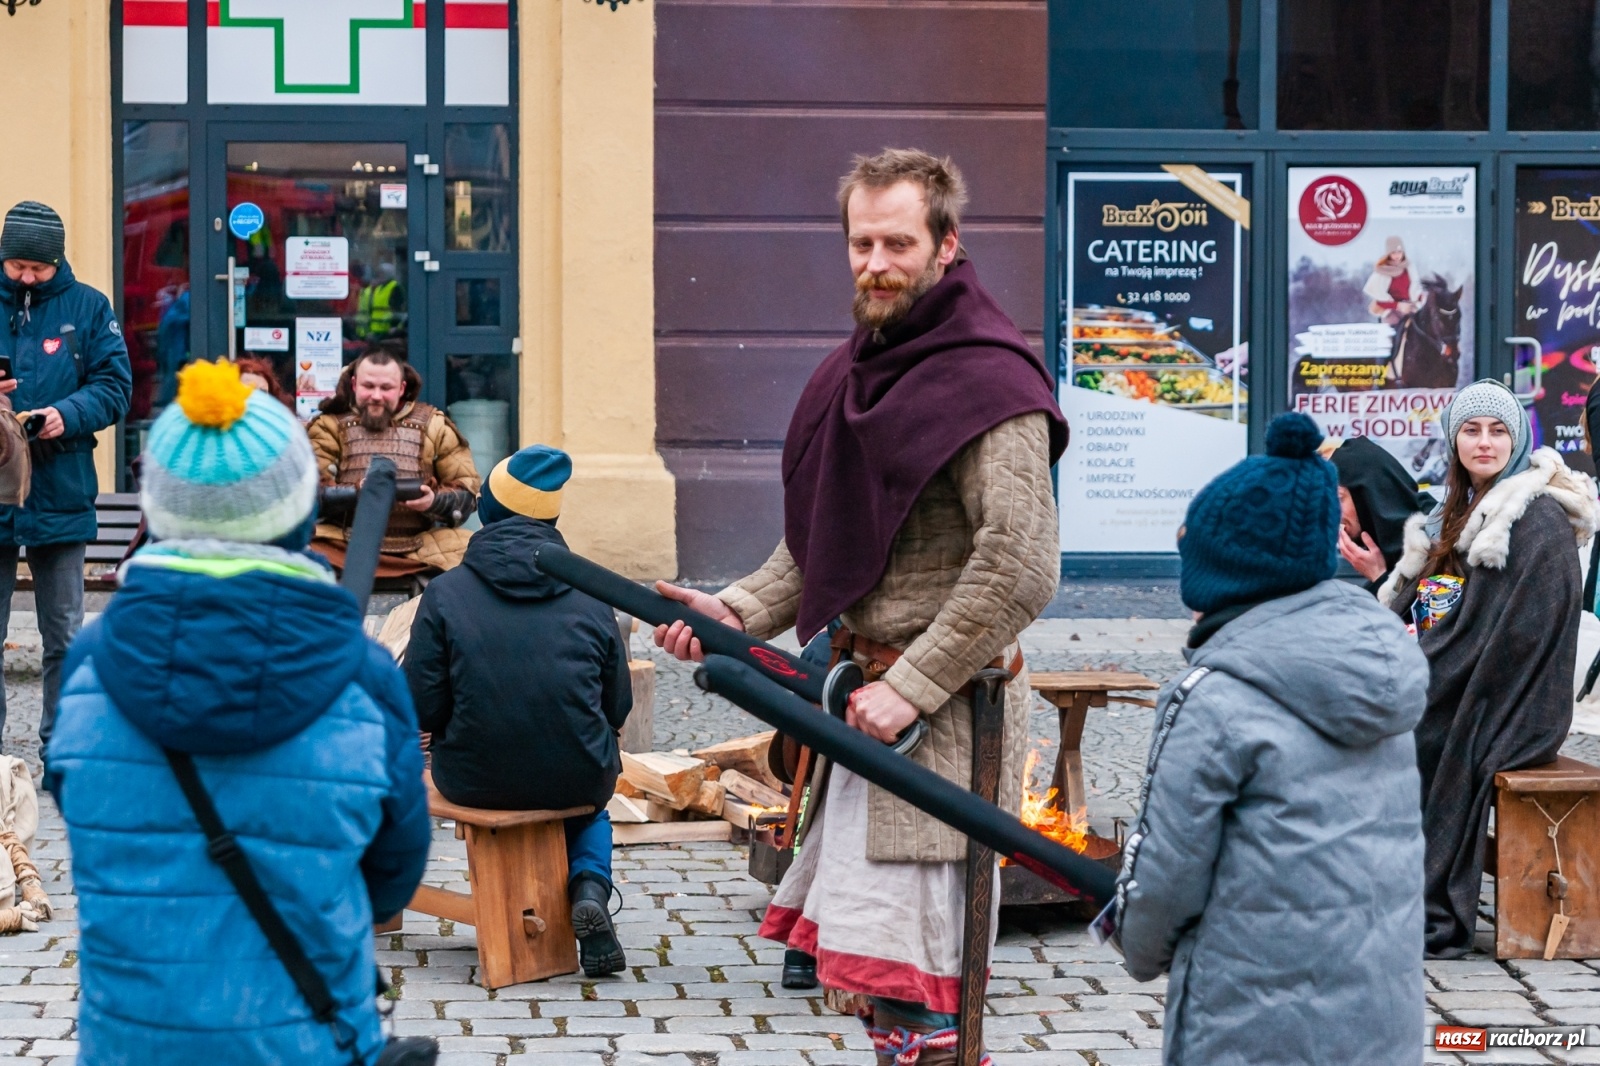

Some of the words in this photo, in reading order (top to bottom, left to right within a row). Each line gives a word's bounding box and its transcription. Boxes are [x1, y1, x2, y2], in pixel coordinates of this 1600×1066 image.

[1087, 240, 1217, 263] CATERING
[1105, 267, 1119, 276] na
[1121, 266, 1153, 279] Twoją
[1153, 266, 1197, 279] imprezę
[1127, 292, 1140, 303] 32
[1142, 290, 1161, 304] 418
[1163, 291, 1191, 303] 1000
[1300, 361, 1389, 378] Zapraszamy
[1297, 394, 1361, 414] FERIE
[1365, 394, 1453, 414] ZIMOW
[1086, 411, 1146, 420] URODZINY
[1086, 425, 1146, 436] DOMÓWKI
[1327, 425, 1345, 437] w
[1351, 419, 1433, 437] SIODLE
[1086, 442, 1129, 452] OBIADY
[1086, 458, 1135, 468] KOLACJE
[1086, 474, 1136, 483] IMPREZY
[1086, 487, 1195, 499] OKOLICZNOŚCIOWE
